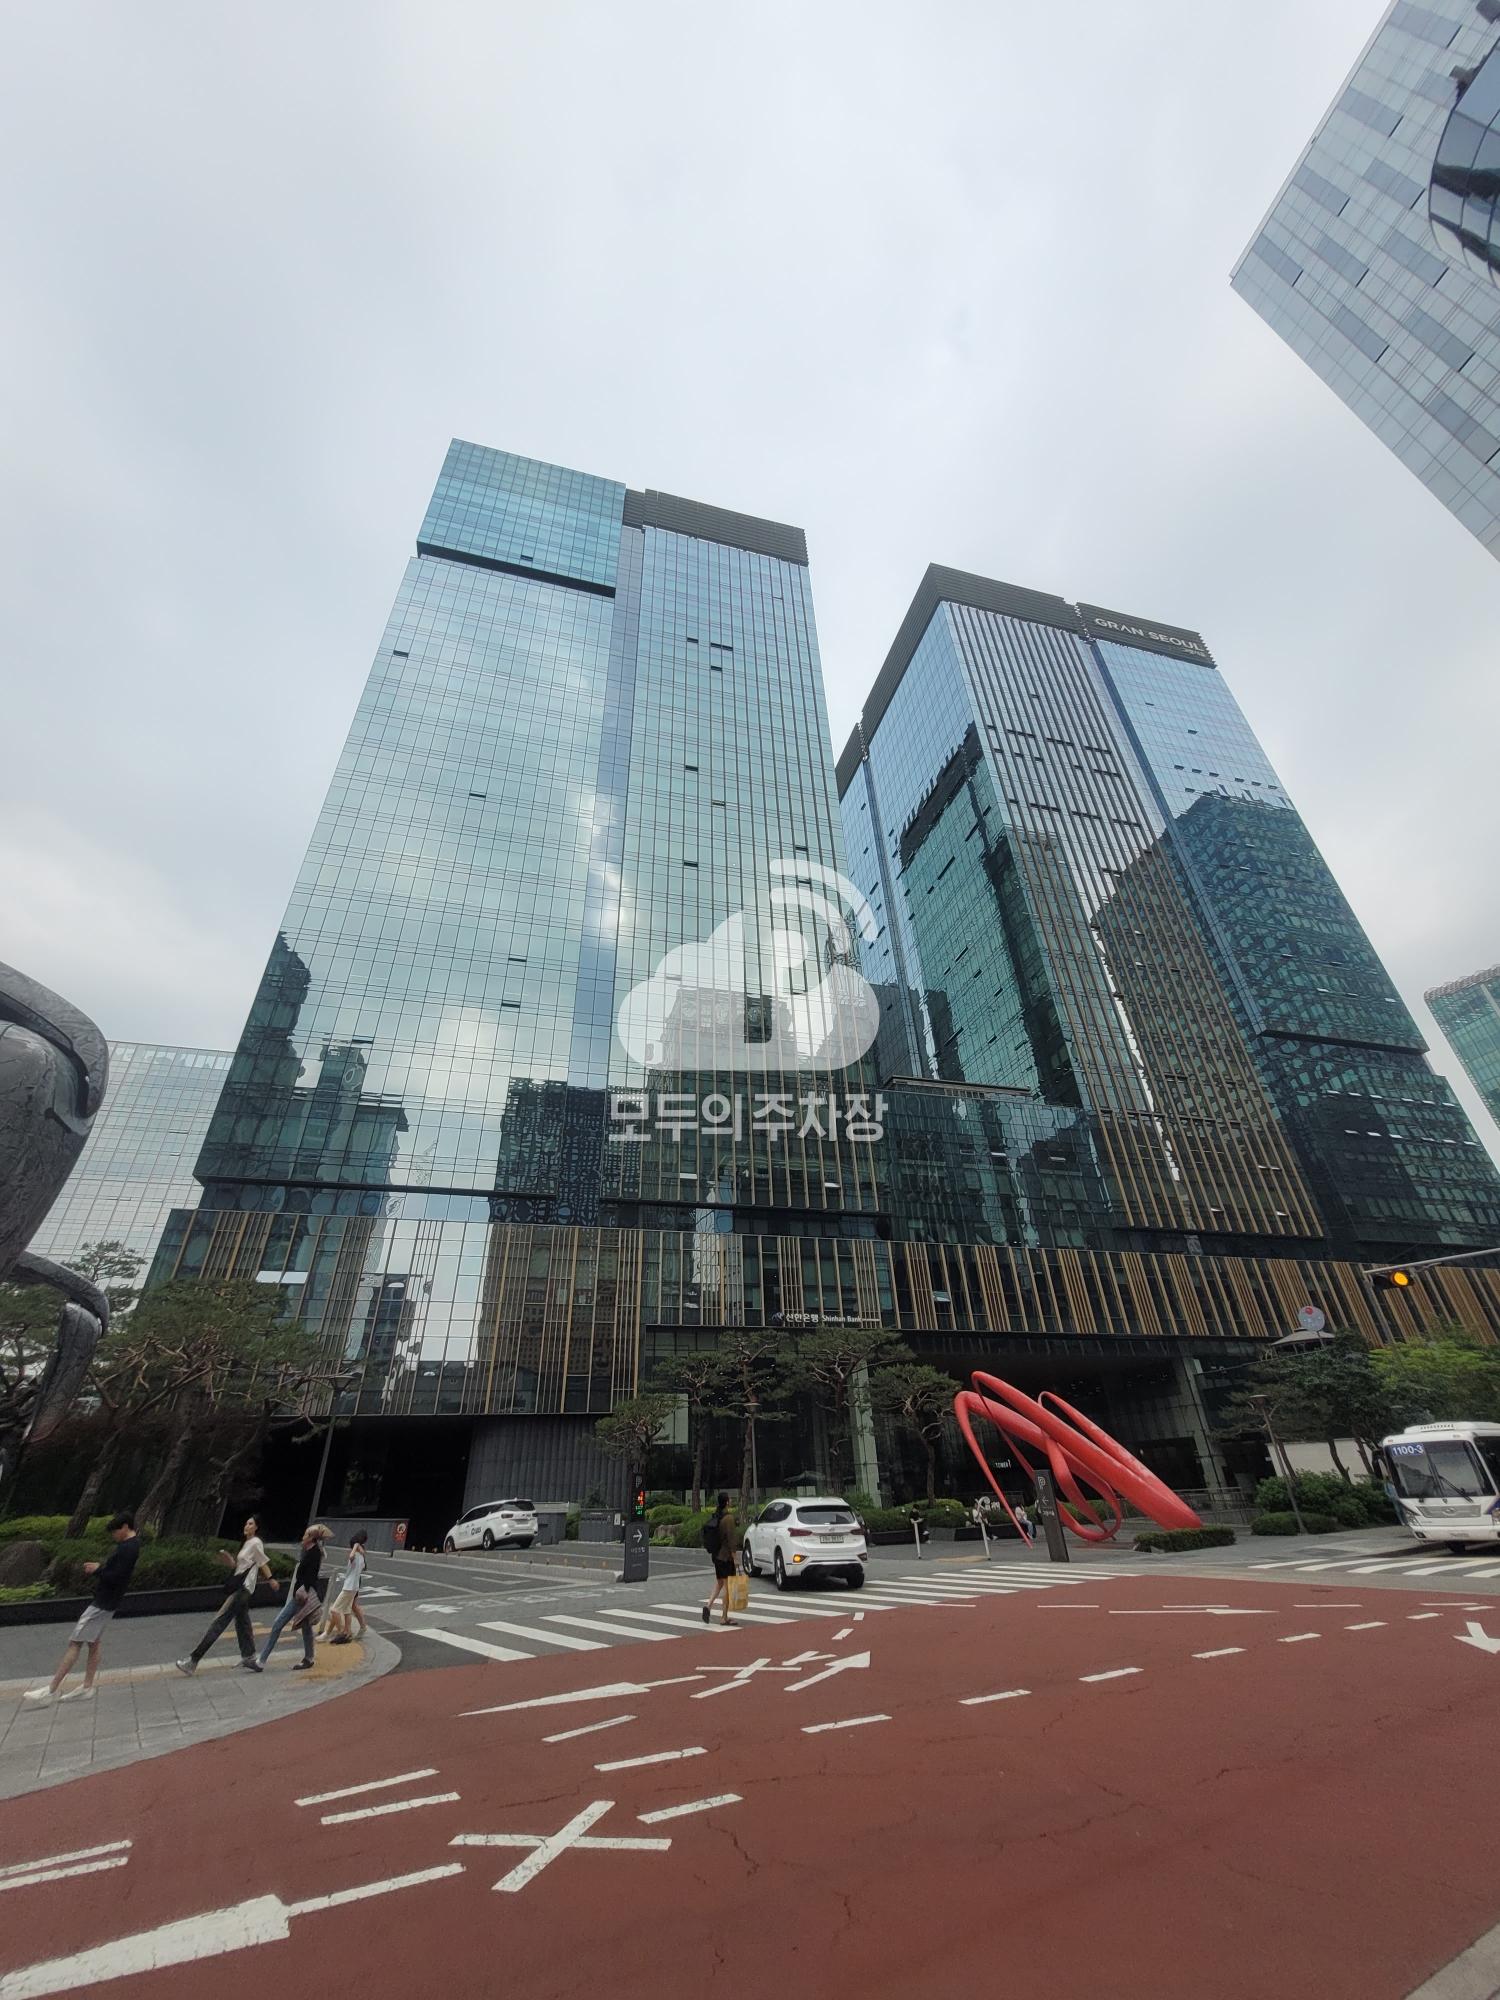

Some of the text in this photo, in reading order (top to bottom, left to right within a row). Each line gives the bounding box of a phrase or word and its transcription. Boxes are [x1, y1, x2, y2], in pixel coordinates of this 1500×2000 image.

[1094, 618, 1206, 651] GRAN SEOUL
[785, 1313, 819, 1323] 신한은행
[821, 1314, 861, 1323] Shinhan Bank
[1392, 1445, 1424, 1456] 1100-3
